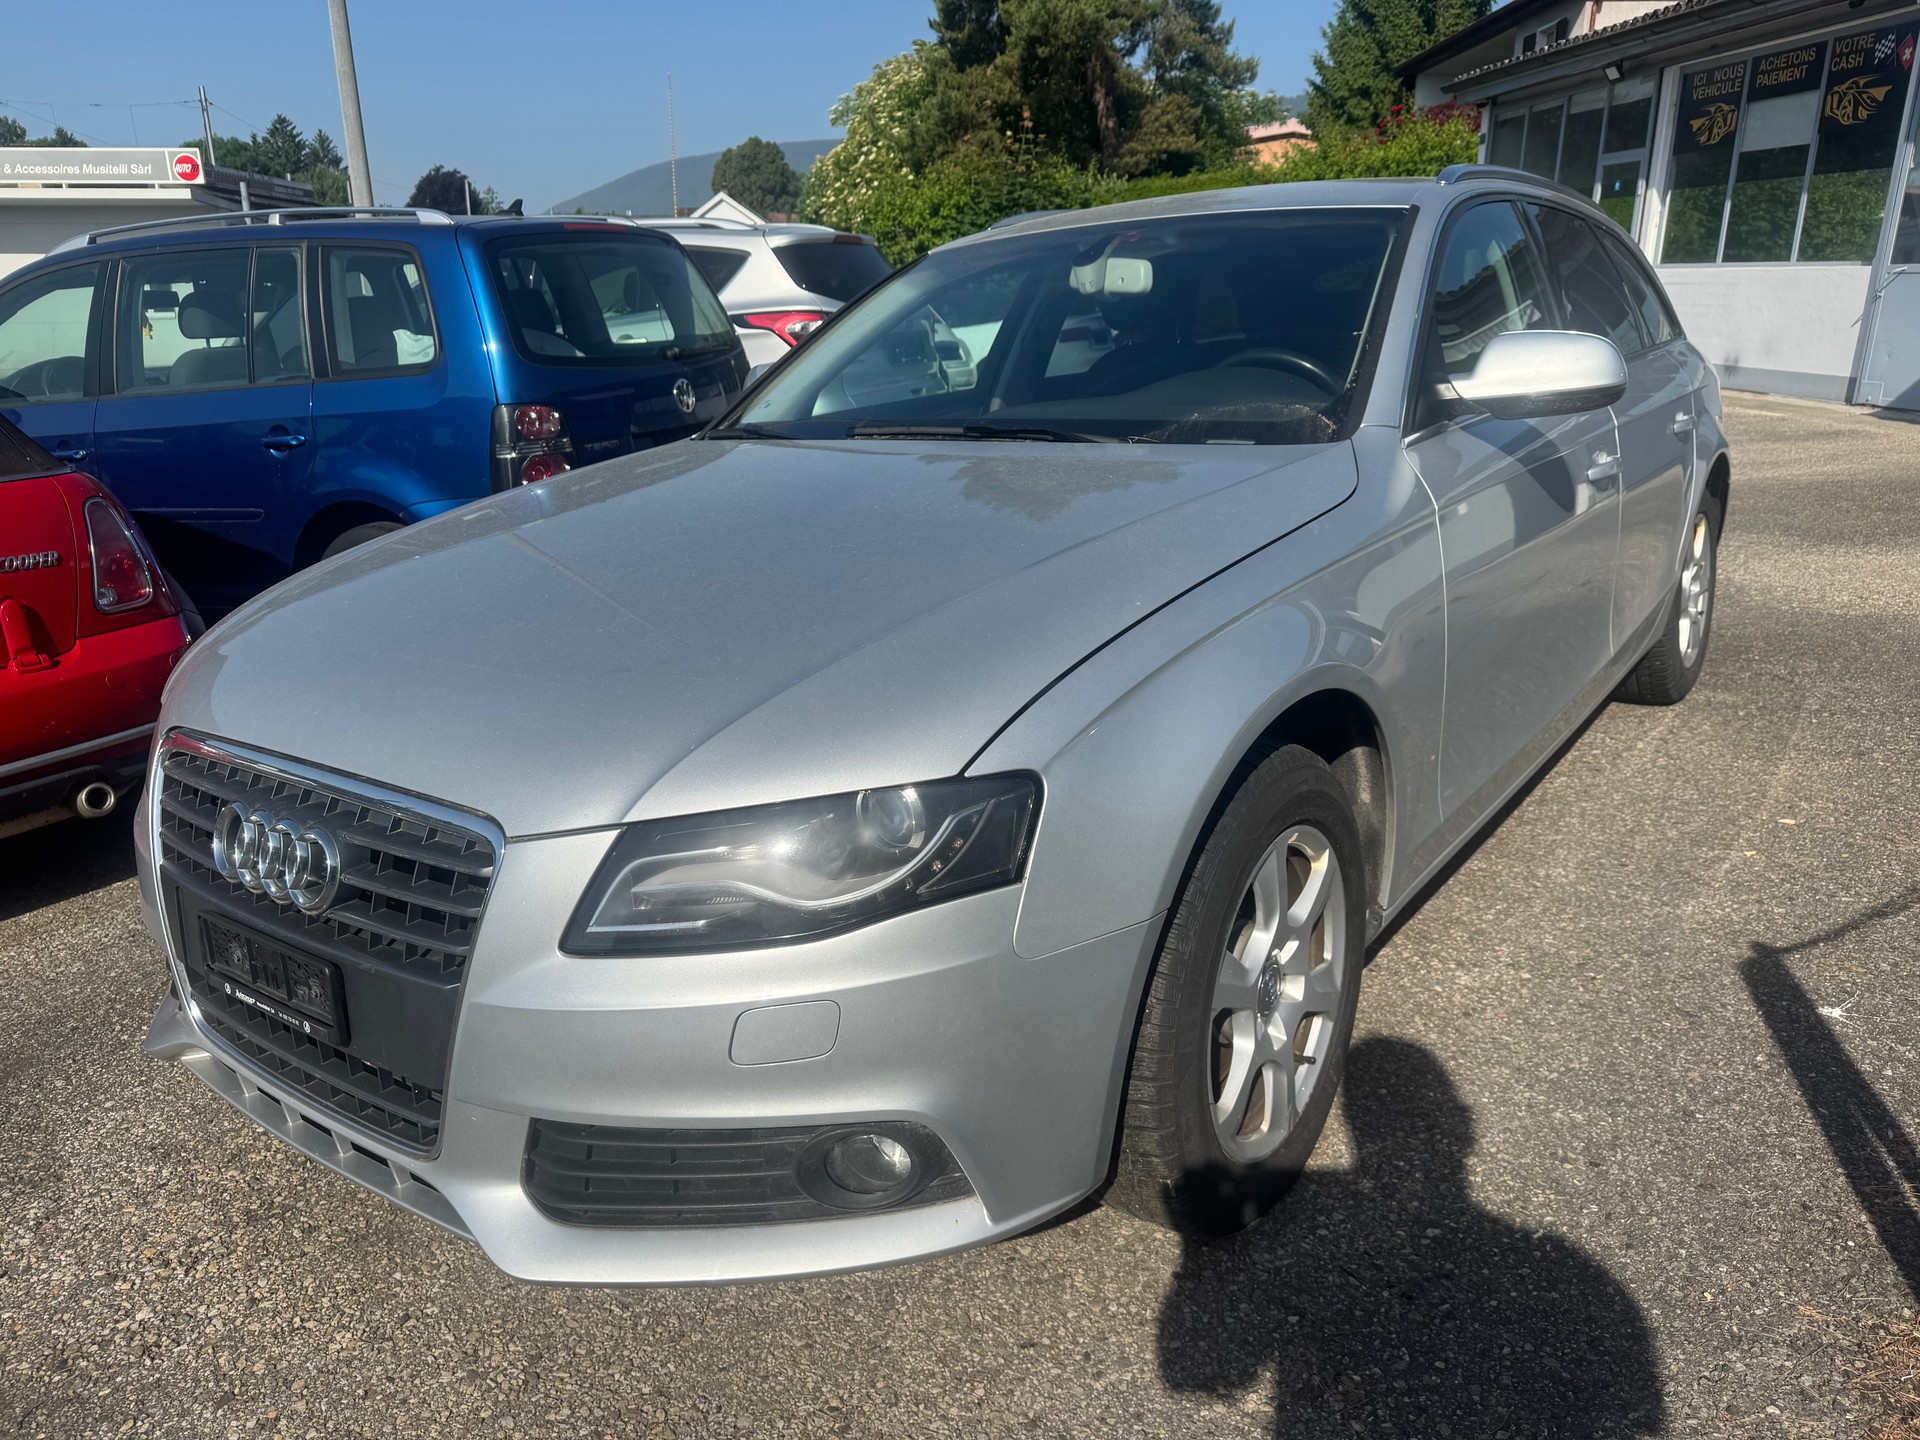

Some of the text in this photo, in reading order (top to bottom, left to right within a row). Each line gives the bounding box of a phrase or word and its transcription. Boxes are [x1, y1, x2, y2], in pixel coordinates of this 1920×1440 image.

[1692, 52, 1865, 100] VEHICULE PAIEMENT CASH
[1693, 33, 1877, 86] ICI NOUS ACHETONS VOTRE
[14, 163, 80, 175] Accessoires
[82, 163, 128, 175] Musitelli
